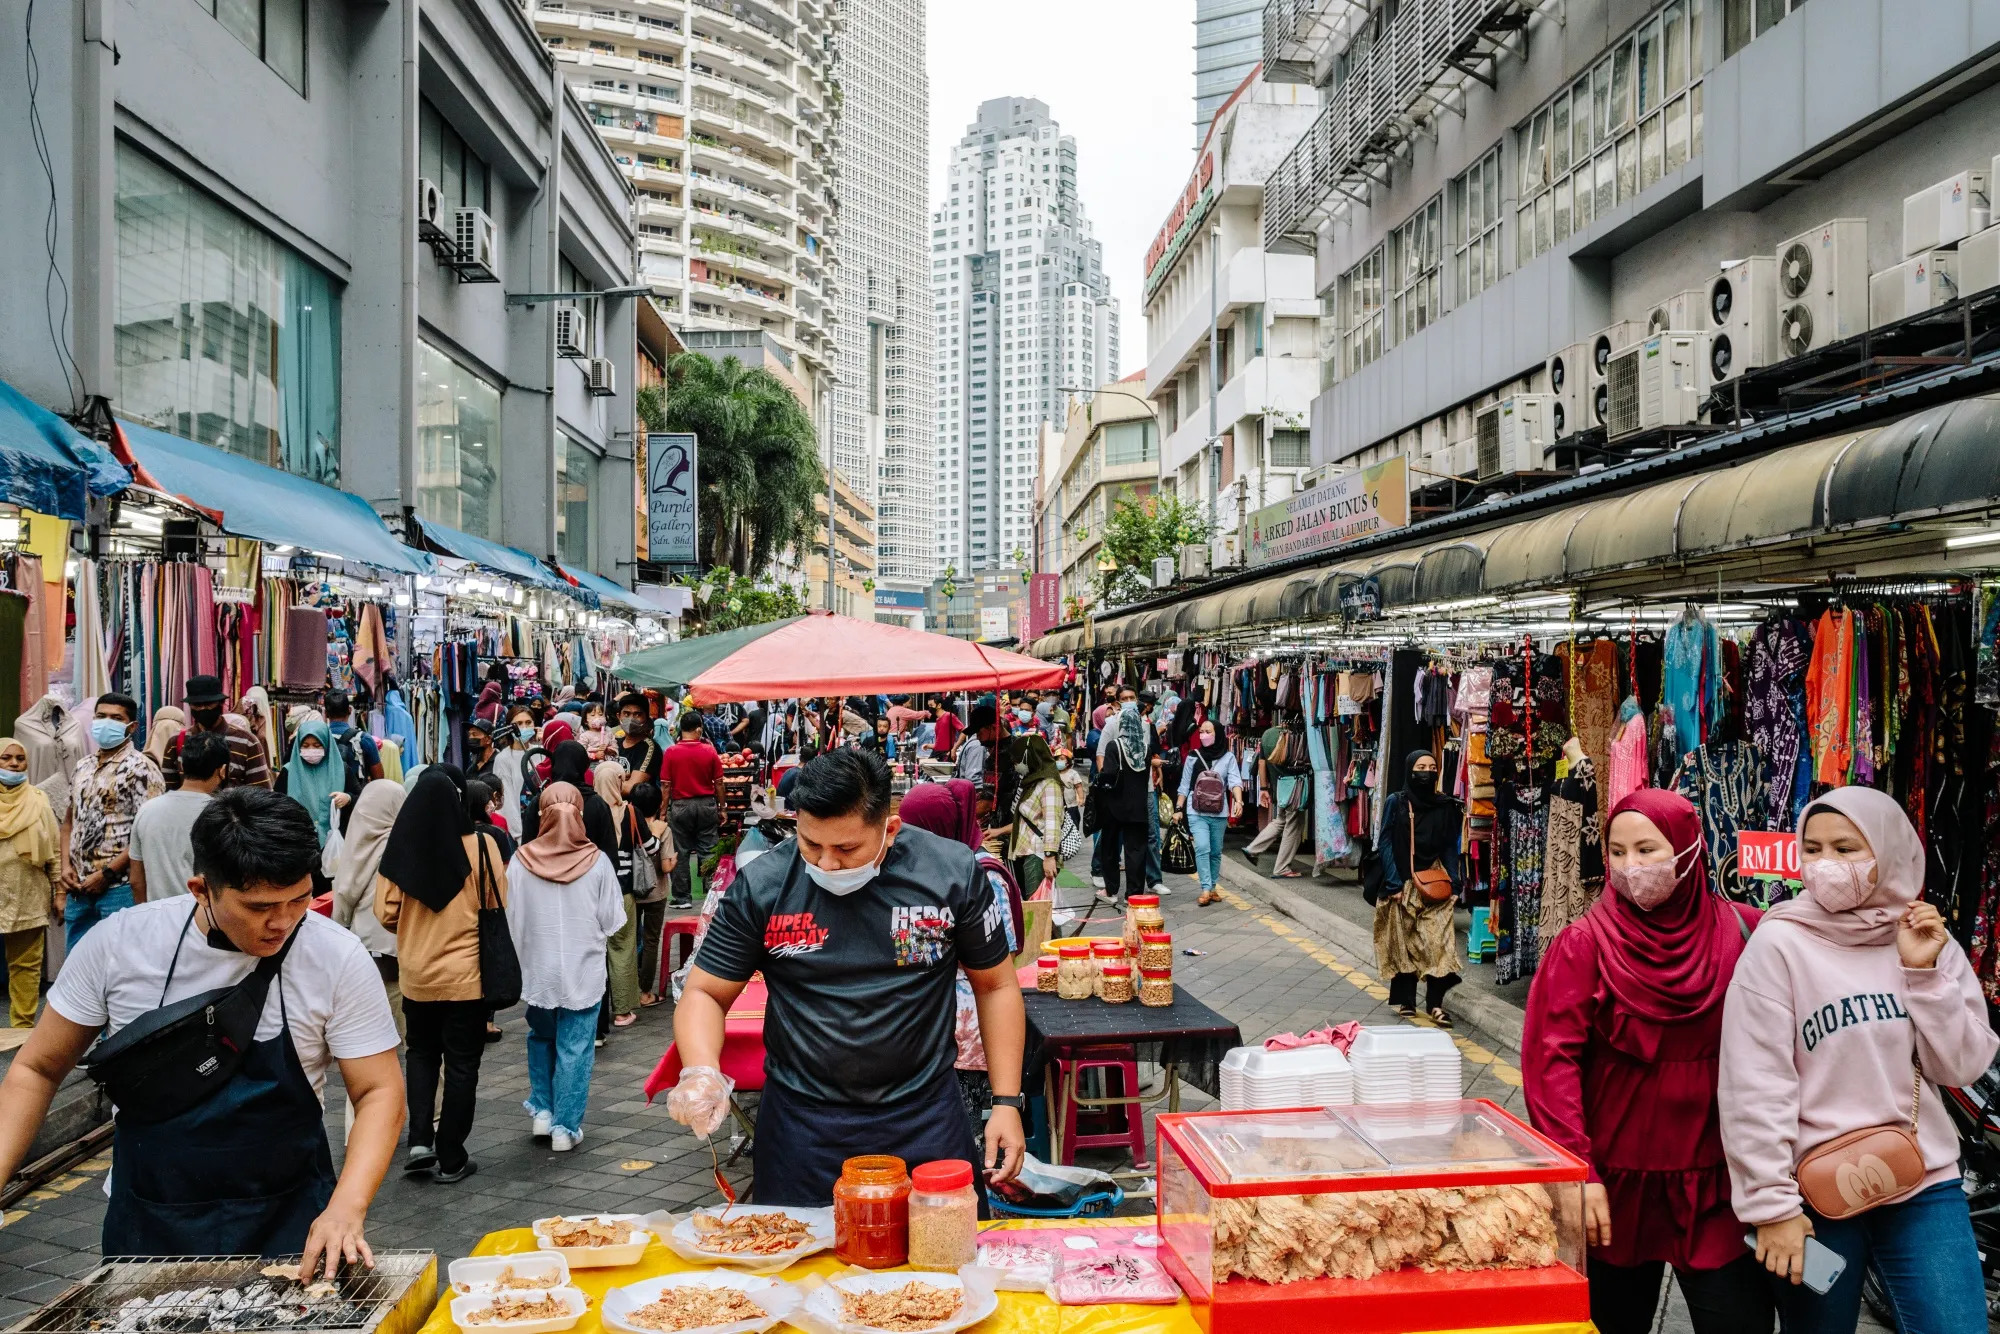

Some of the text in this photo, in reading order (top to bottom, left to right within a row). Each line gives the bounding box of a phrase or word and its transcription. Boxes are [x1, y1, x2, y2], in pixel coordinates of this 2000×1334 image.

[651, 499, 692, 517] Purple
[1286, 482, 1347, 515] SELAMAT DATANG
[1264, 490, 1378, 542] ARKED JALAN BUNUS 6
[651, 519, 692, 534] Gallery
[652, 535, 692, 545] Sdn. Bhd.
[1264, 517, 1379, 558] DEWAN BANDARAYA KUALA LUMPUR
[883, 596, 898, 605] BANK
[1741, 840, 1801, 873] RM10
[766, 912, 818, 932] UPER.
[764, 928, 829, 949] SUNDAY
[195, 1056, 218, 1073] VANS
